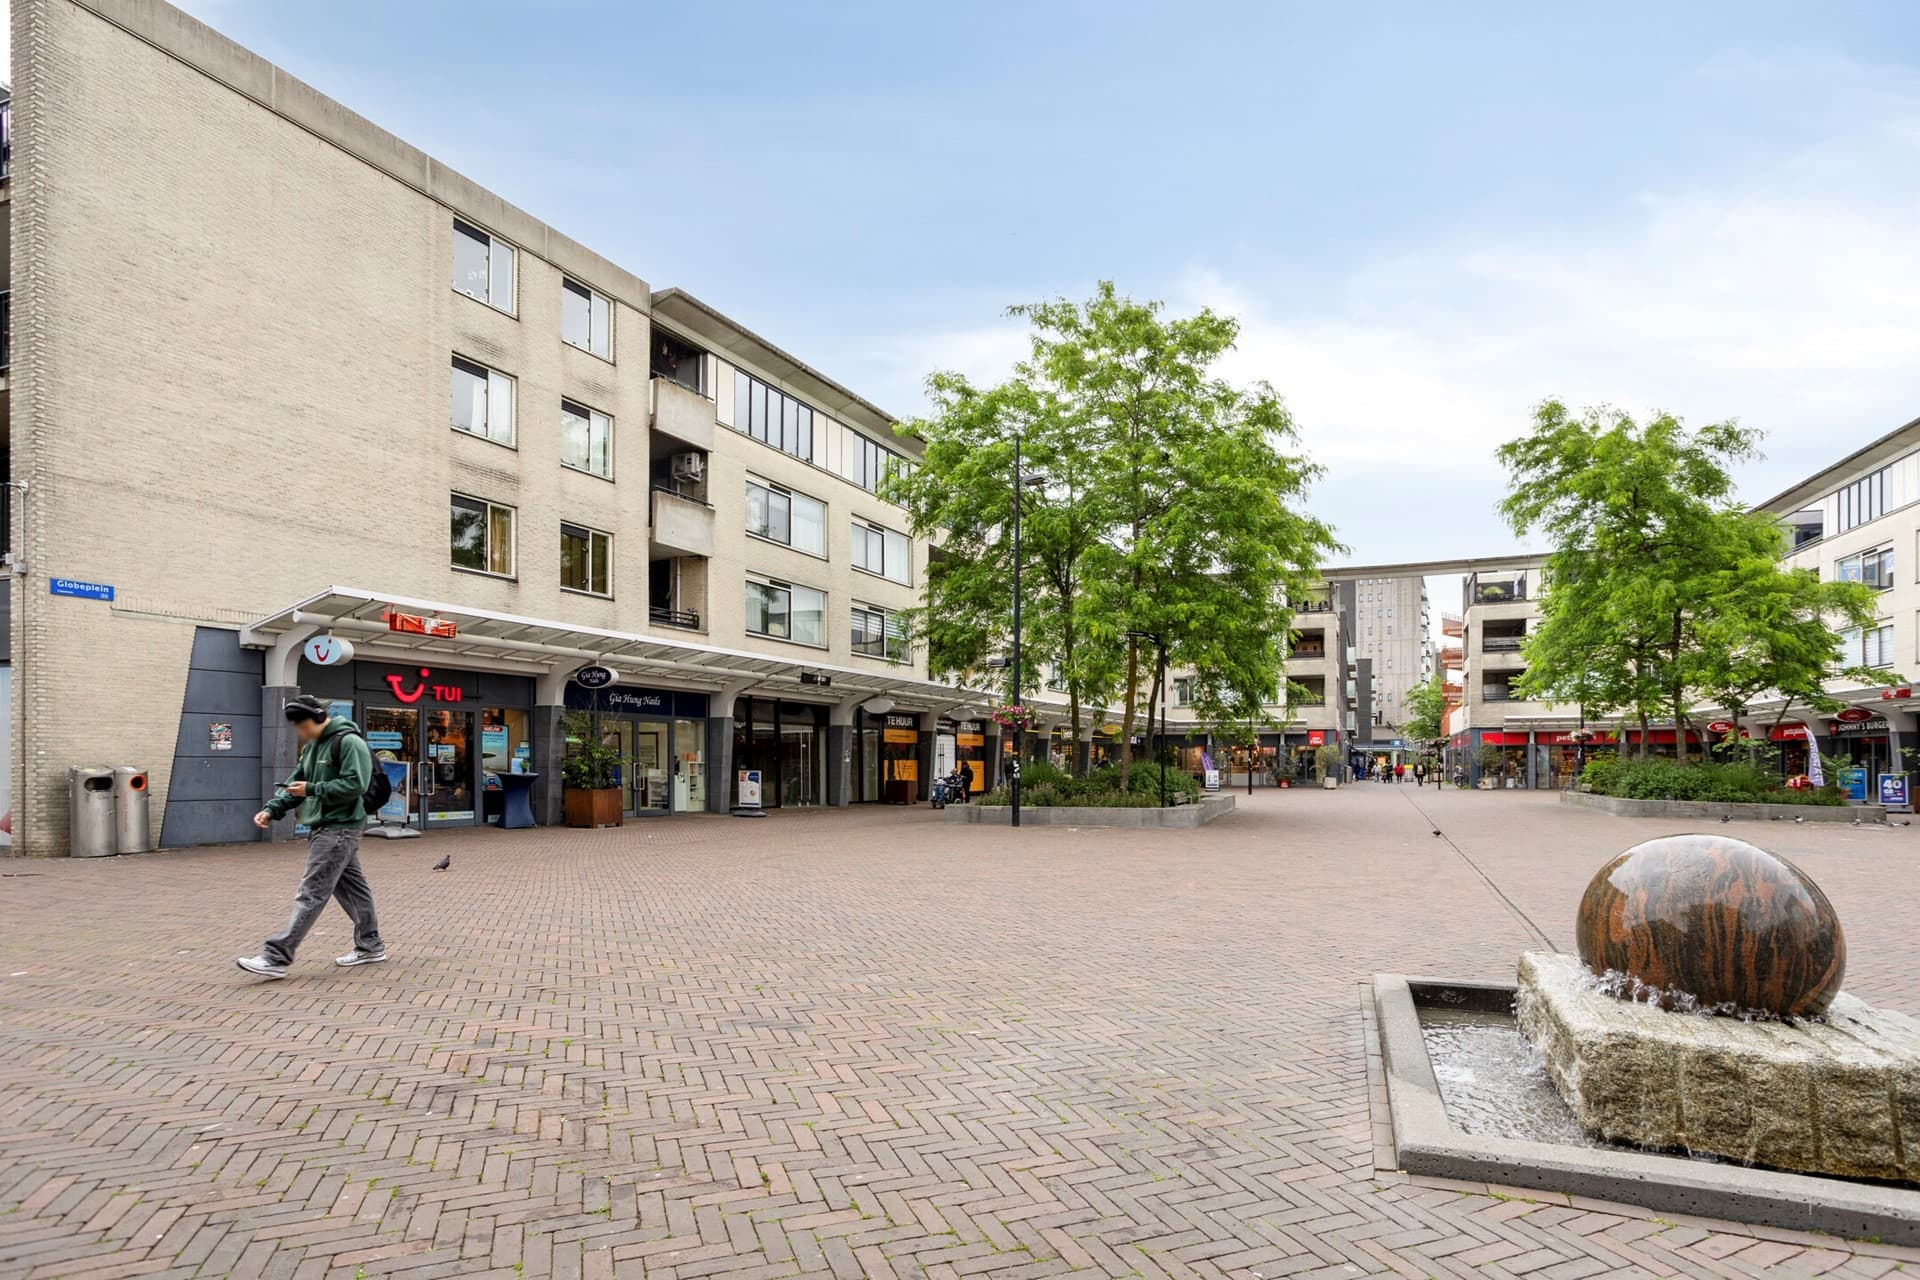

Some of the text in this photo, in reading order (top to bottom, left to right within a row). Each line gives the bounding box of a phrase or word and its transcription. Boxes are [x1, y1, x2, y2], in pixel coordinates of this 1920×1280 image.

[57, 580, 109, 593] Globeplein
[432, 685, 462, 702] TUI
[609, 693, 661, 707] Gia Hung Nails
[896, 716, 913, 727] HUUR
[1882, 779, 1902, 789] 40
